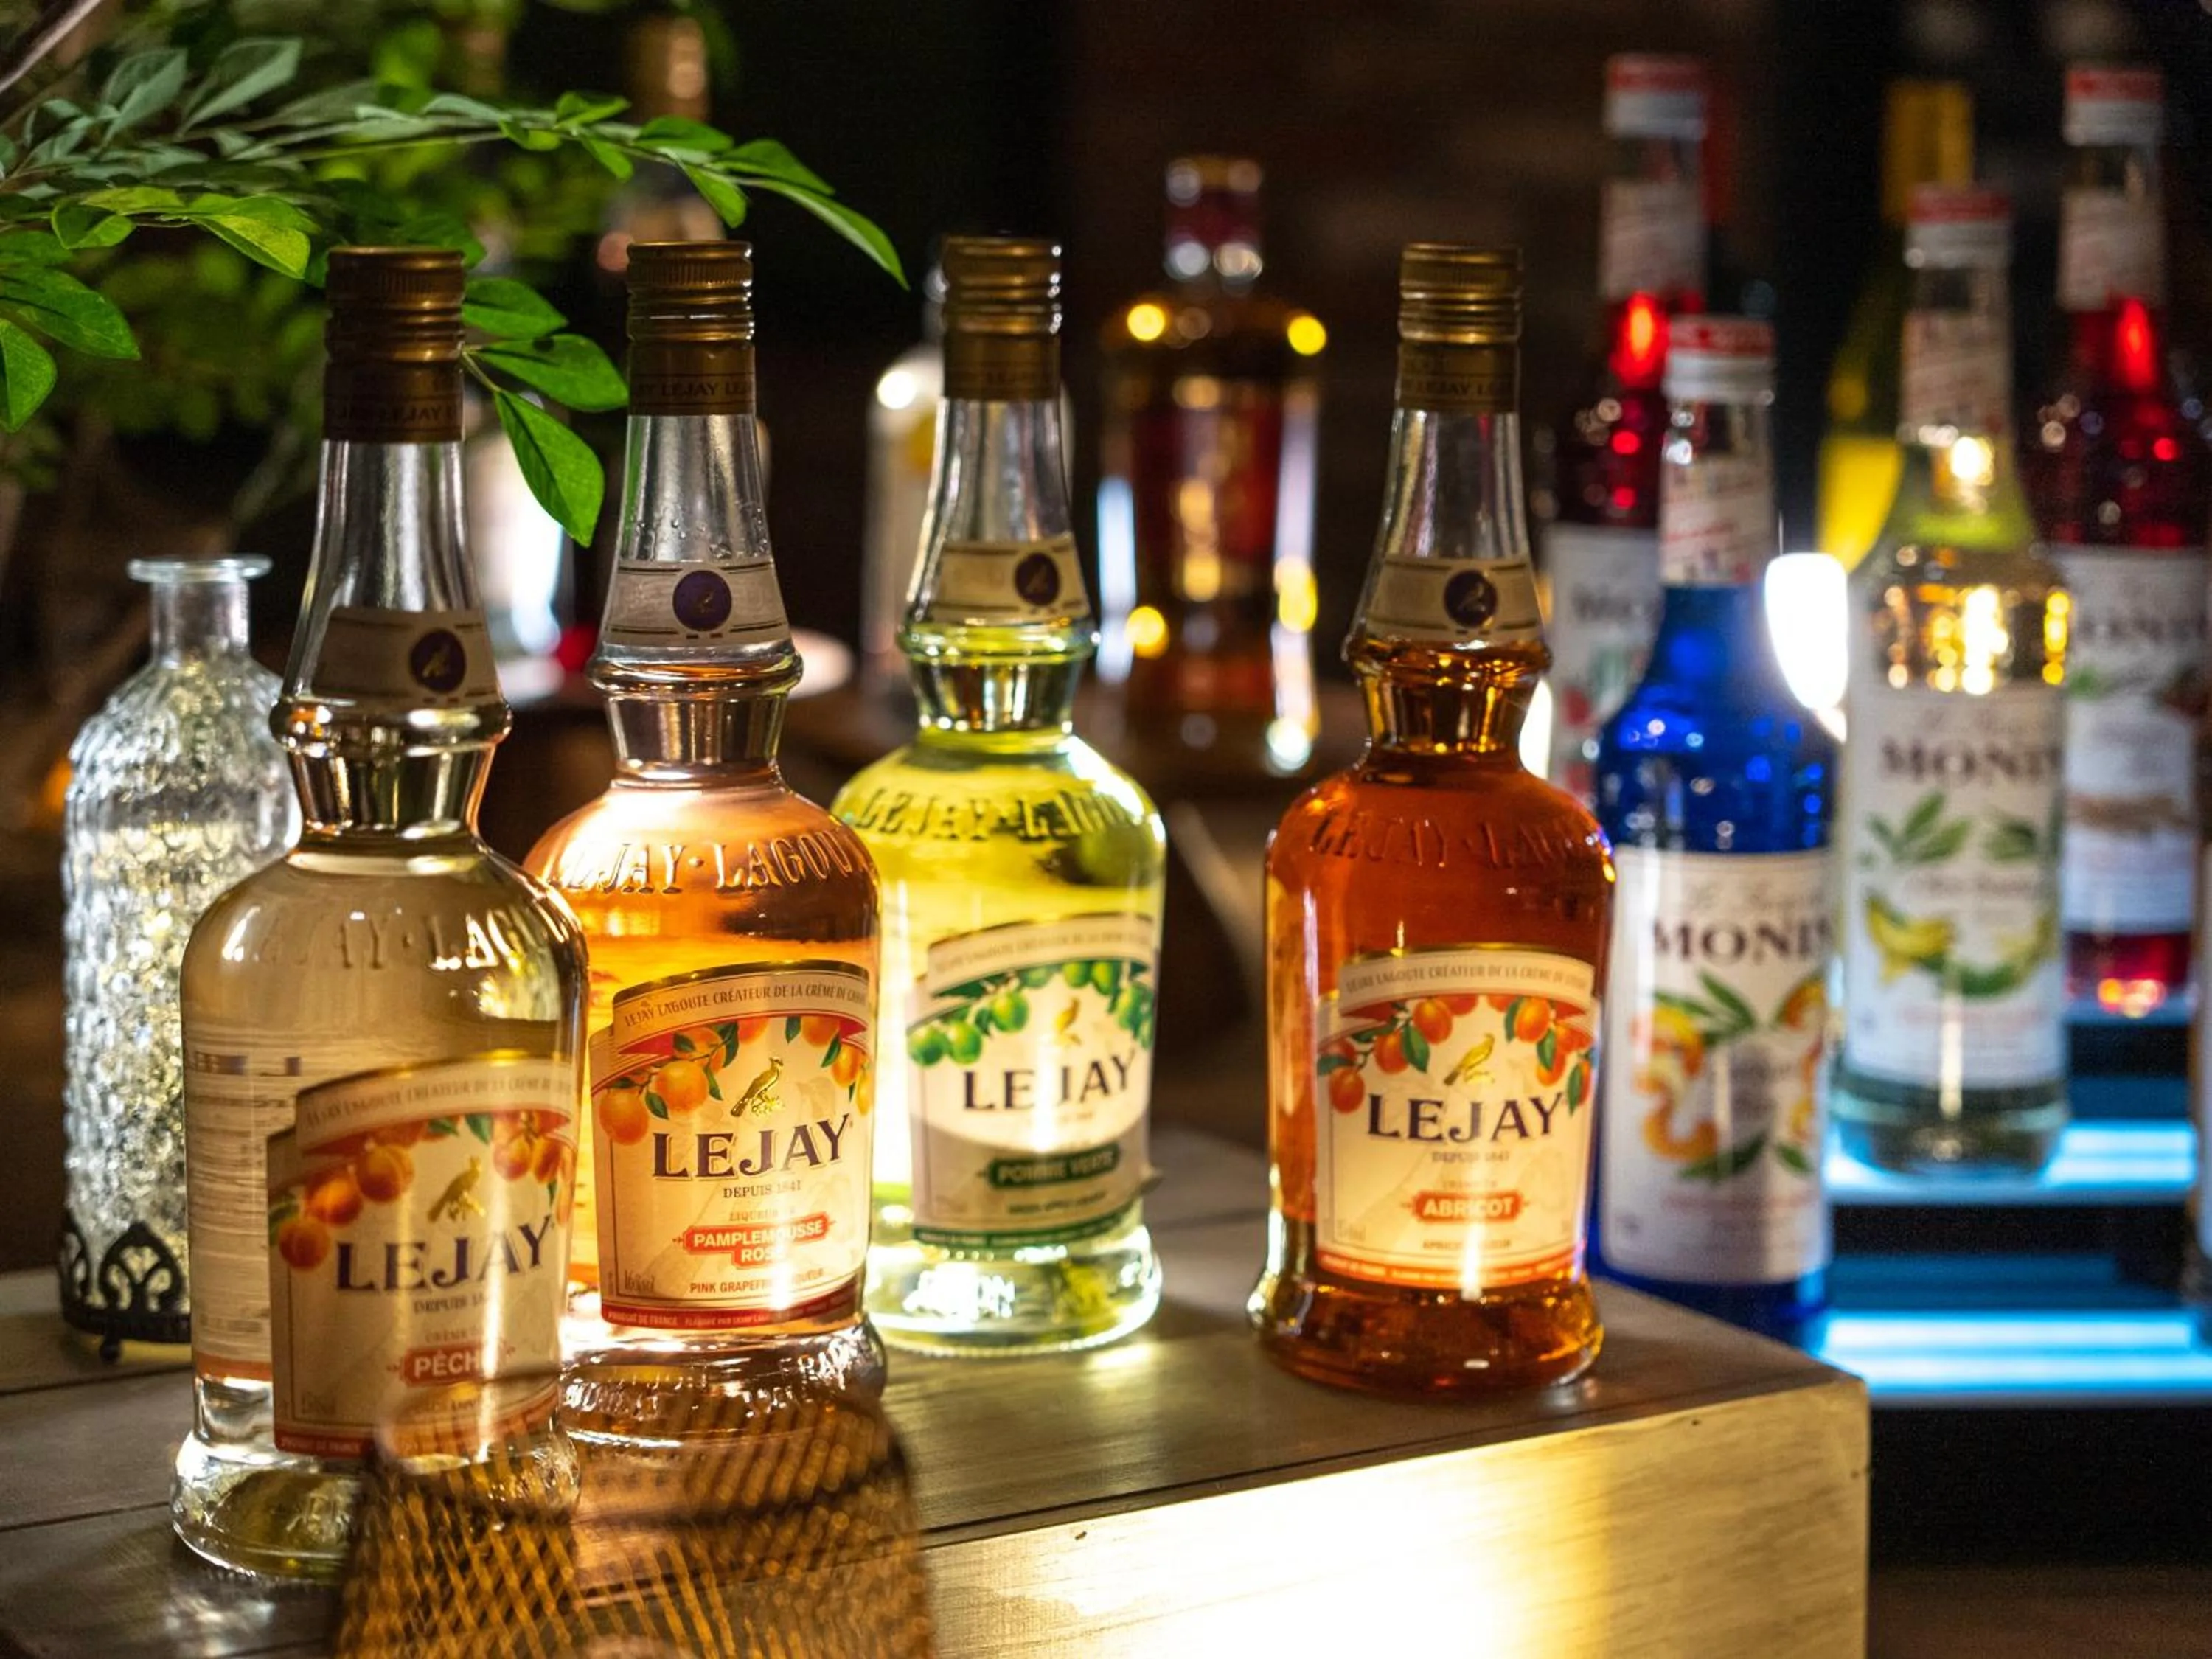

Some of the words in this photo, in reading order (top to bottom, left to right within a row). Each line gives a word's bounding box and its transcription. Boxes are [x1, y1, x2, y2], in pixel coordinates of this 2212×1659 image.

[774, 984, 787, 999] DE
[790, 984, 803, 998] LA
[1367, 1091, 1562, 1143] LEJAY
[652, 1113, 850, 1180] LEJAY
[723, 1184, 772, 1199] DEPUIS
[336, 1215, 552, 1292] LEJAY
[690, 1281, 717, 1294] PINK
